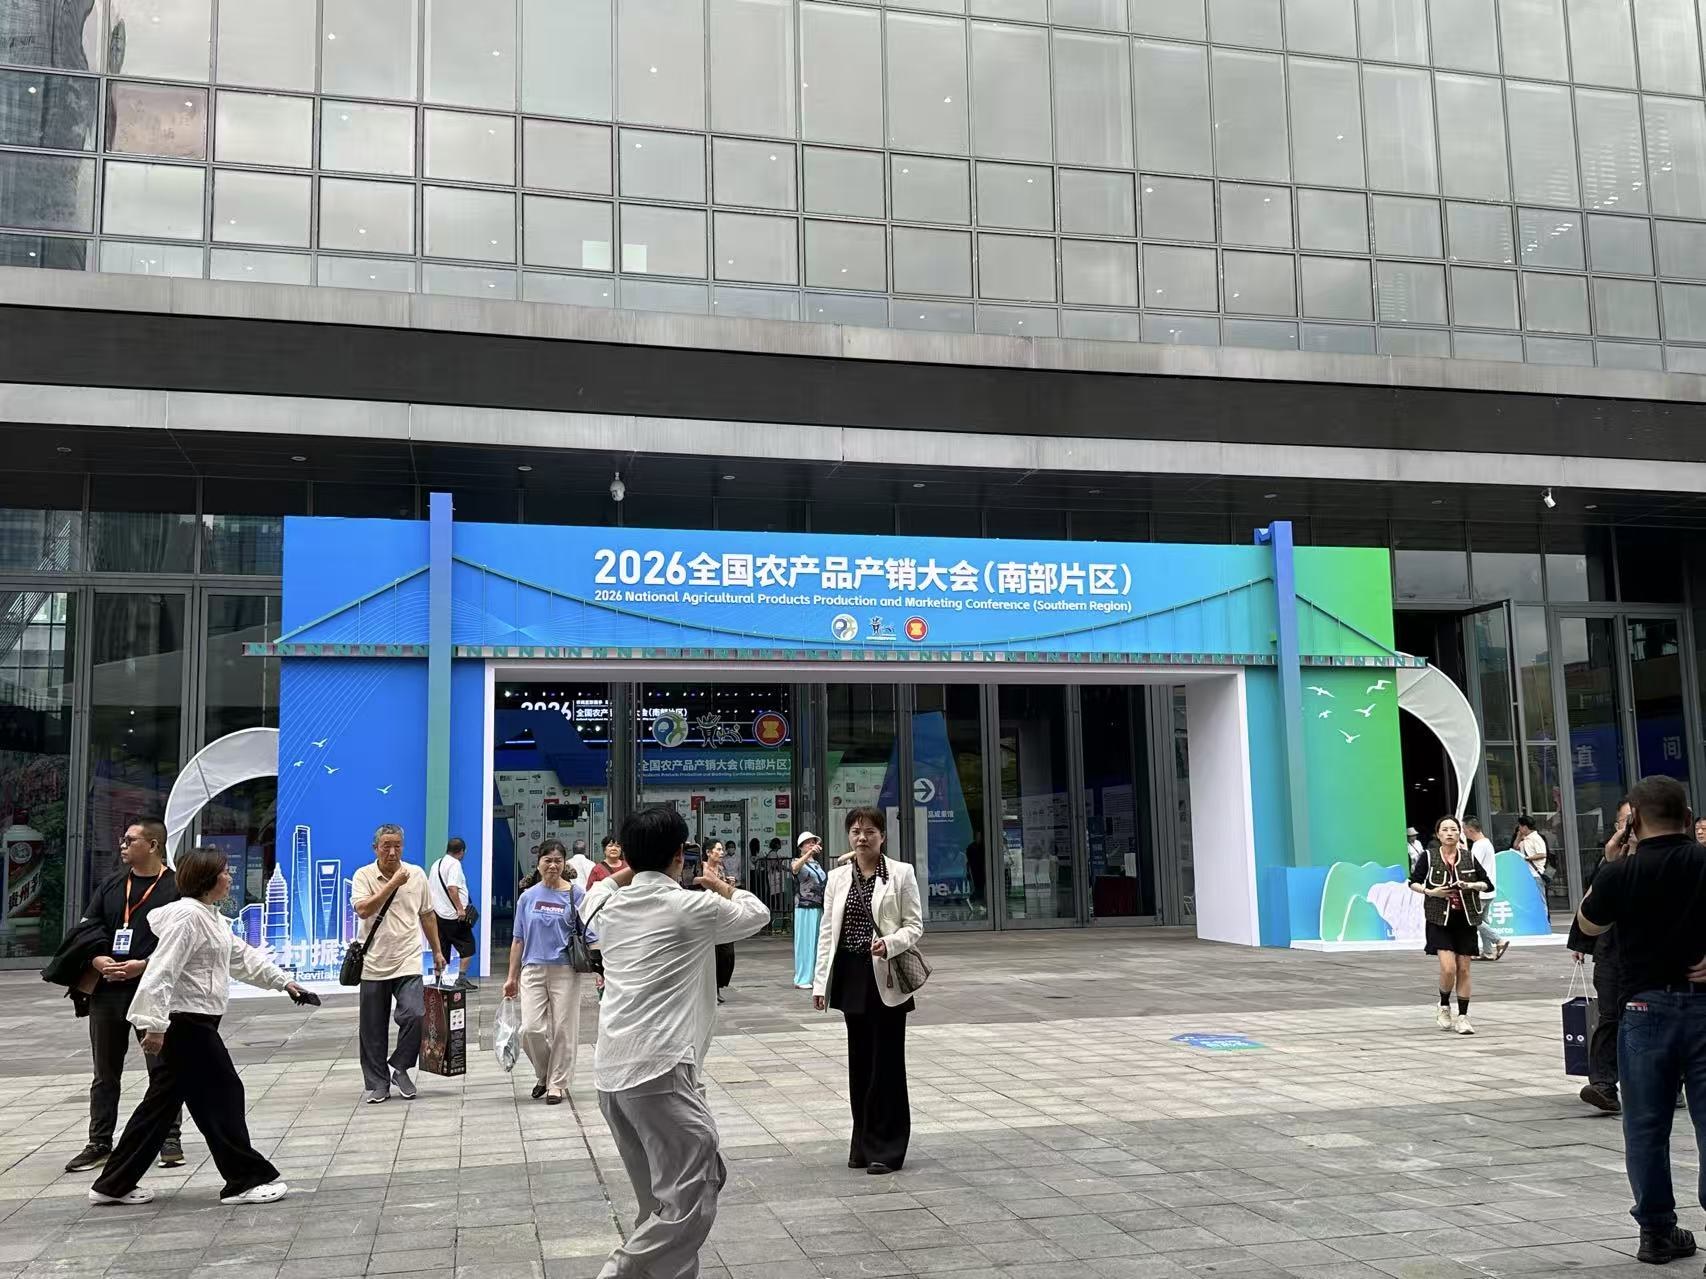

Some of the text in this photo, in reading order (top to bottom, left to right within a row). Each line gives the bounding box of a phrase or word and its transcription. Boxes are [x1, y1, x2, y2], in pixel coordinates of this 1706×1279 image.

[594, 549, 1132, 595] 2026全国农产品产销大会（南部片区）
[594, 590, 1132, 613] 2026 National Agricultural Products Production and Marketing Conference (Southern Region)
